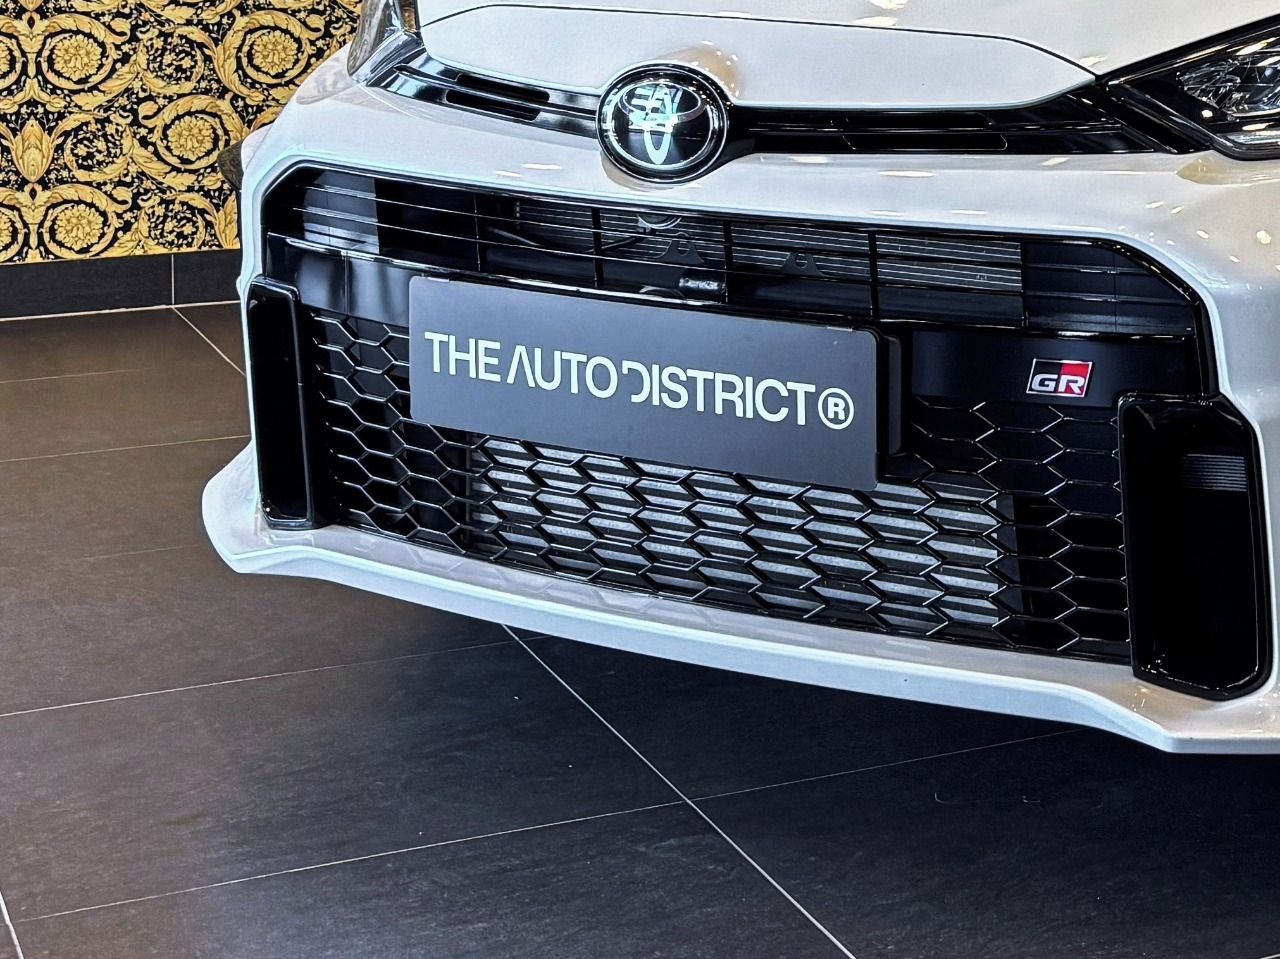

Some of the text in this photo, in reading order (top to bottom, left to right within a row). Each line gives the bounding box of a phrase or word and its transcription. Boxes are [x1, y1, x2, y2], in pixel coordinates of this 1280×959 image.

[424, 332, 501, 382] THE
[506, 345, 618, 398] AUTO
[1031, 373, 1085, 394] GR
